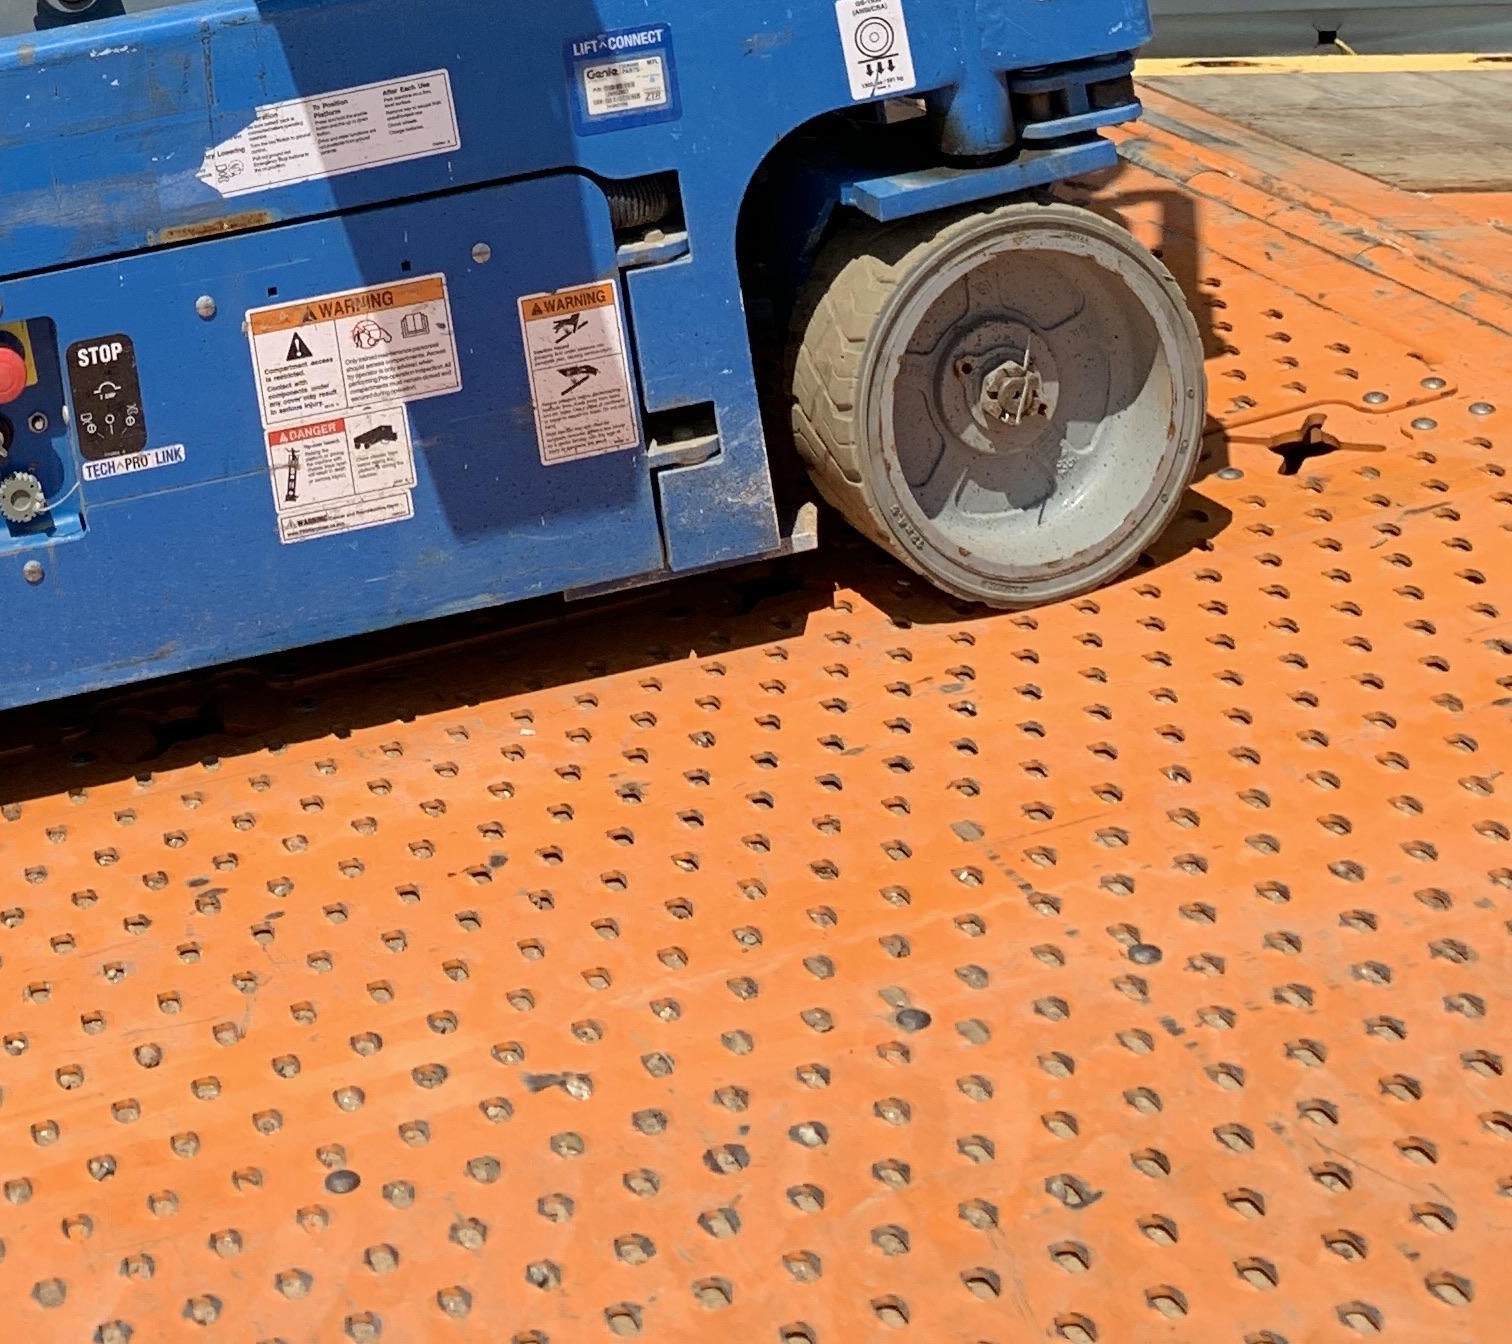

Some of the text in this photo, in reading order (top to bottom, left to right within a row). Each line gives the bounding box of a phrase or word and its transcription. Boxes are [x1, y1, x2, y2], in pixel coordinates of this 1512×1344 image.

[571, 28, 665, 56] LIFT CONNECT
[585, 65, 618, 80] Genie
[317, 290, 394, 318] WARNING
[543, 289, 607, 313] WARNING
[76, 341, 125, 368] STOP
[287, 421, 337, 440] DANGER
[85, 460, 116, 478] TECH
[154, 447, 183, 465] LINK
